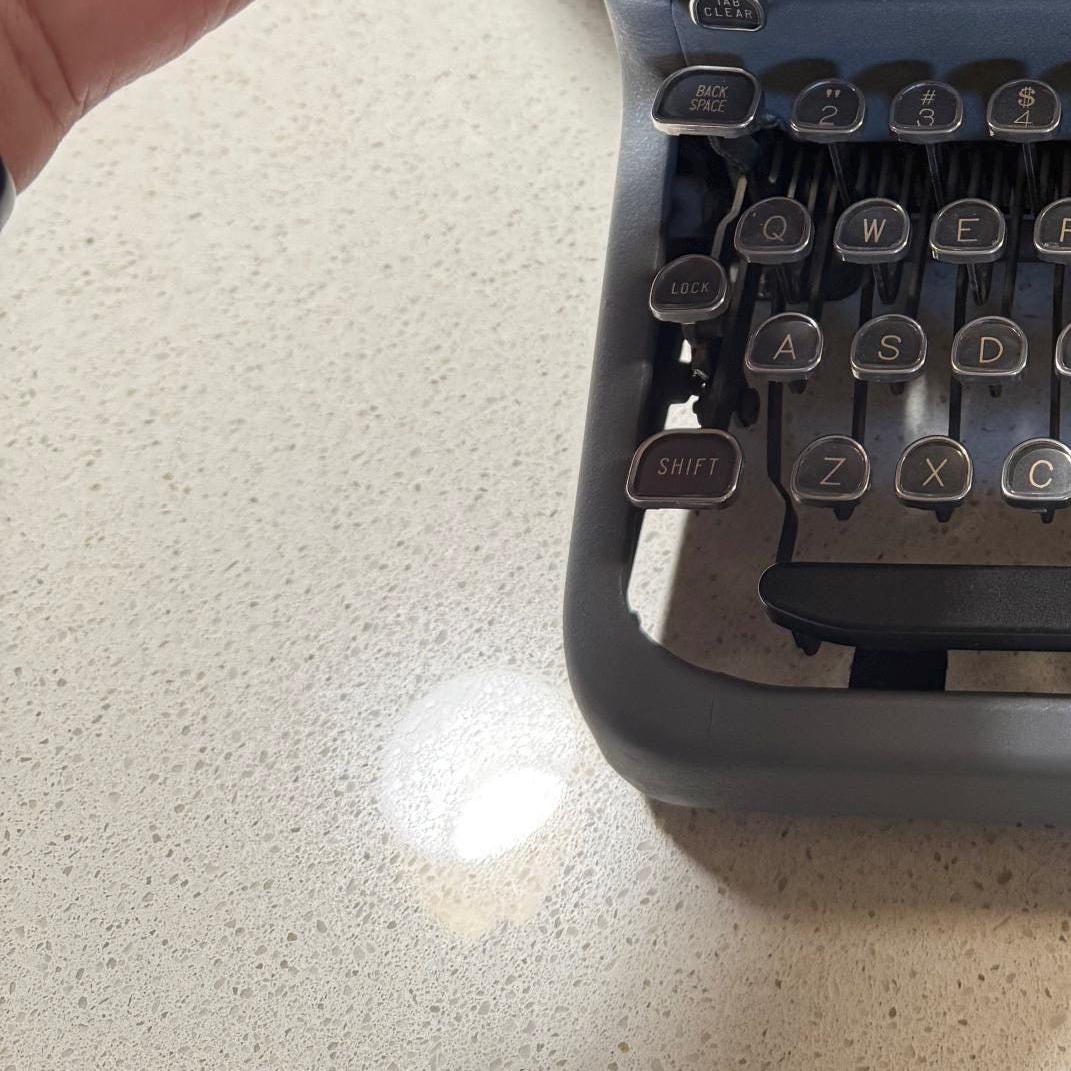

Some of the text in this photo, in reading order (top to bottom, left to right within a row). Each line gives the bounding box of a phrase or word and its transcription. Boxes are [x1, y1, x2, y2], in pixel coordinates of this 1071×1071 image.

[704, 7, 754, 19] CLEAR
[695, 84, 729, 97] BACK
[920, 89, 936, 105] #
[1017, 86, 1036, 108] $
[688, 99, 728, 113] SPACE
[818, 105, 839, 126] 2
[916, 108, 935, 127] 3
[1013, 110, 1033, 128] 4
[762, 215, 787, 242] Q
[863, 218, 887, 243] W
[956, 217, 980, 242] E
[671, 281, 710, 295] LOCK
[772, 333, 797, 361] A
[877, 334, 902, 361] S
[978, 336, 1004, 364] D
[657, 457, 720, 476] SHIFT
[819, 457, 846, 486] Z
[922, 458, 948, 487] X
[1028, 459, 1054, 489] C
